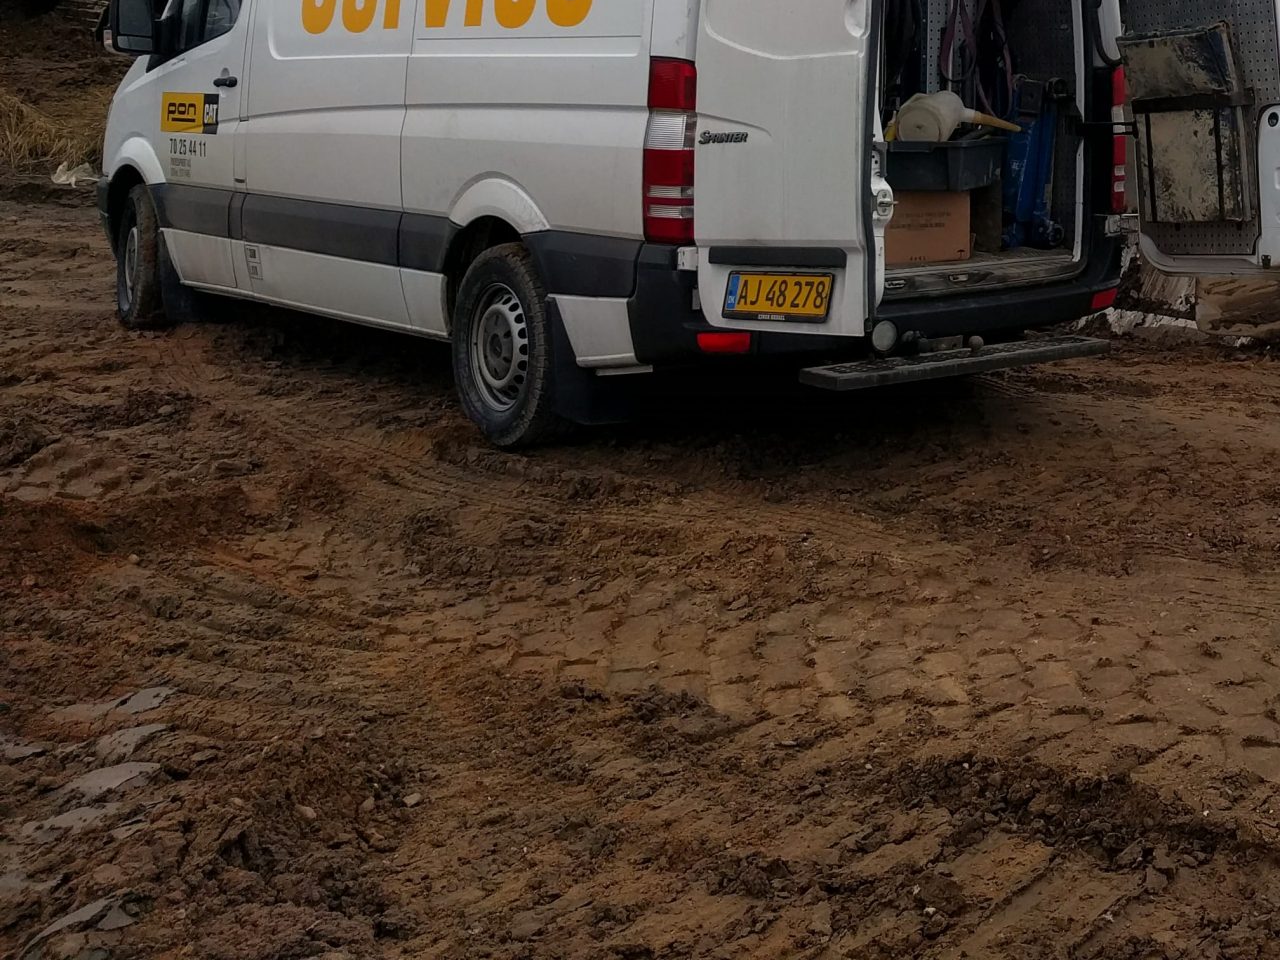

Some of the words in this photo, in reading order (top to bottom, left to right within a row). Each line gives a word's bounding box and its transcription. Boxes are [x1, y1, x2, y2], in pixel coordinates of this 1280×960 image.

[167, 102, 197, 122] pon
[204, 104, 218, 124] CAT
[698, 130, 748, 144] SPRINTER
[169, 138, 178, 155] 70
[179, 139, 187, 155] 25
[189, 140, 197, 156] 44
[199, 141, 207, 157] 11
[737, 279, 763, 306] AJ
[765, 279, 788, 308] 48
[790, 281, 826, 309] 278
